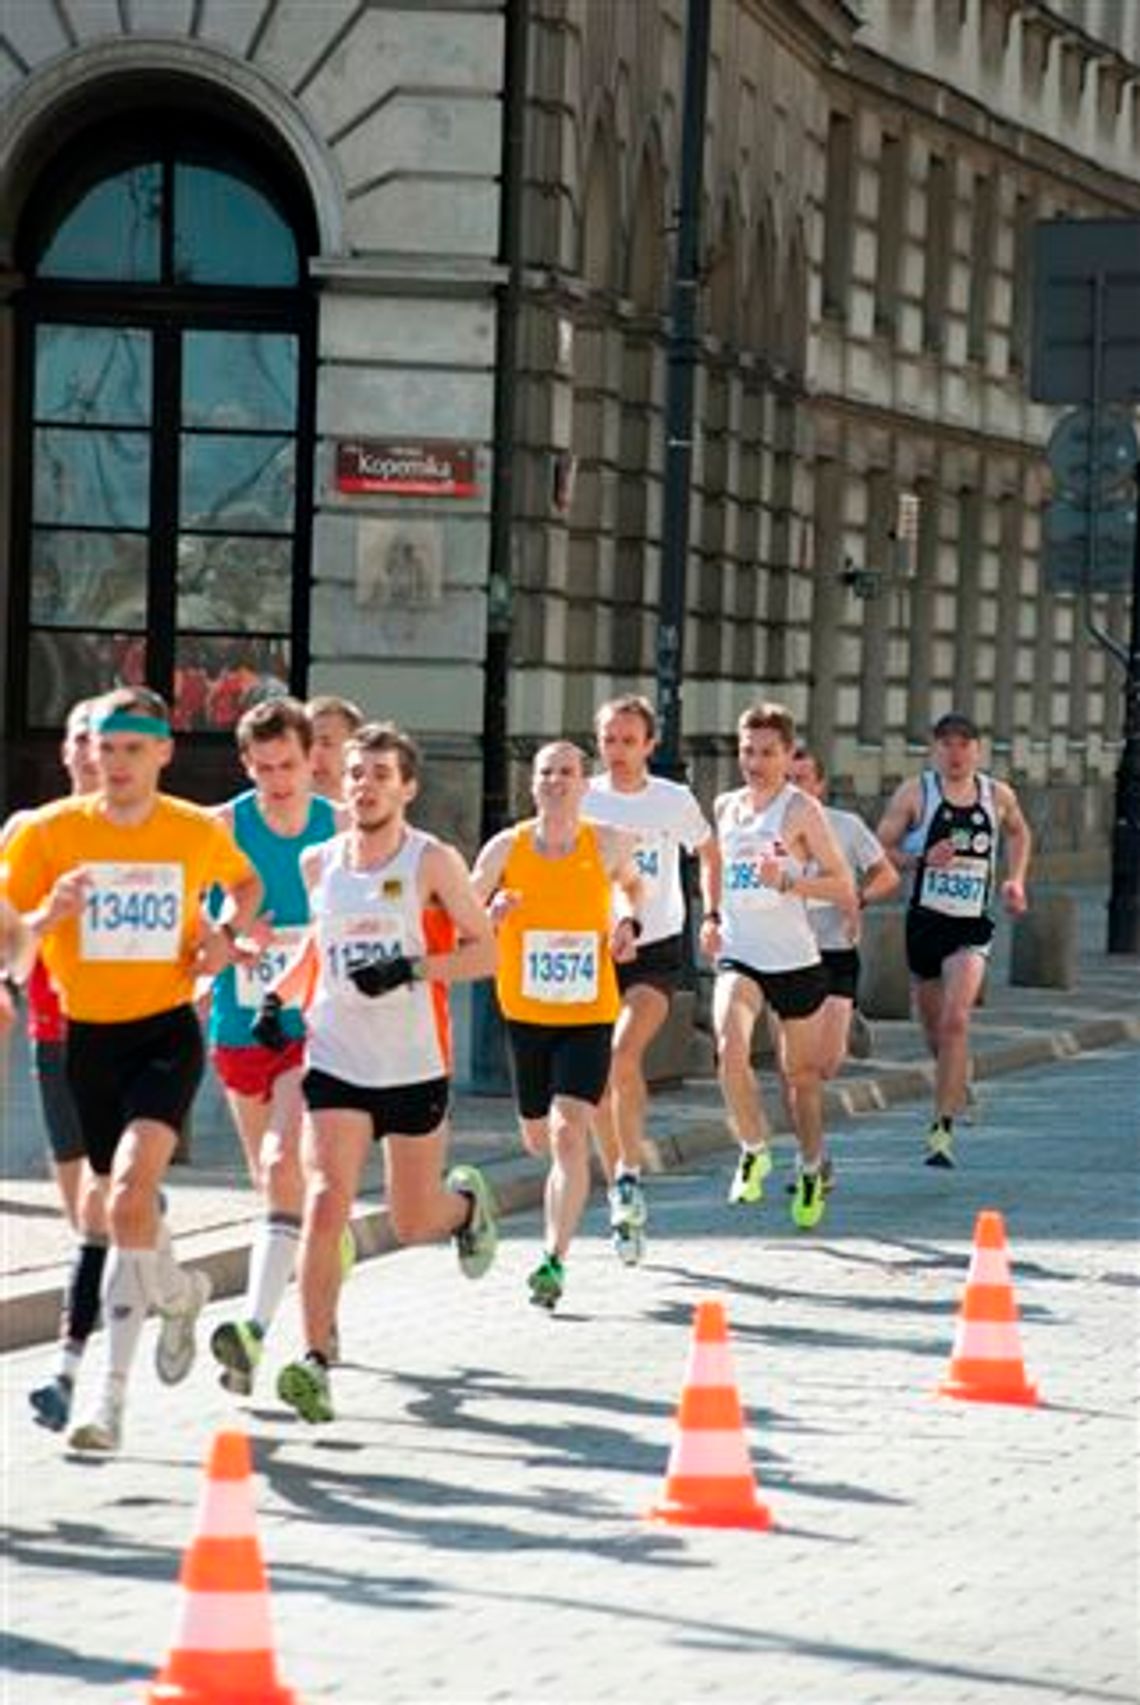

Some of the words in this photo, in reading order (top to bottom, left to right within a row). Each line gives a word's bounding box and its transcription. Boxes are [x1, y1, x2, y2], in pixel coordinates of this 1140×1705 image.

[926, 869, 983, 903] 13387
[87, 890, 177, 931] 13403
[529, 951, 594, 982] 13574
